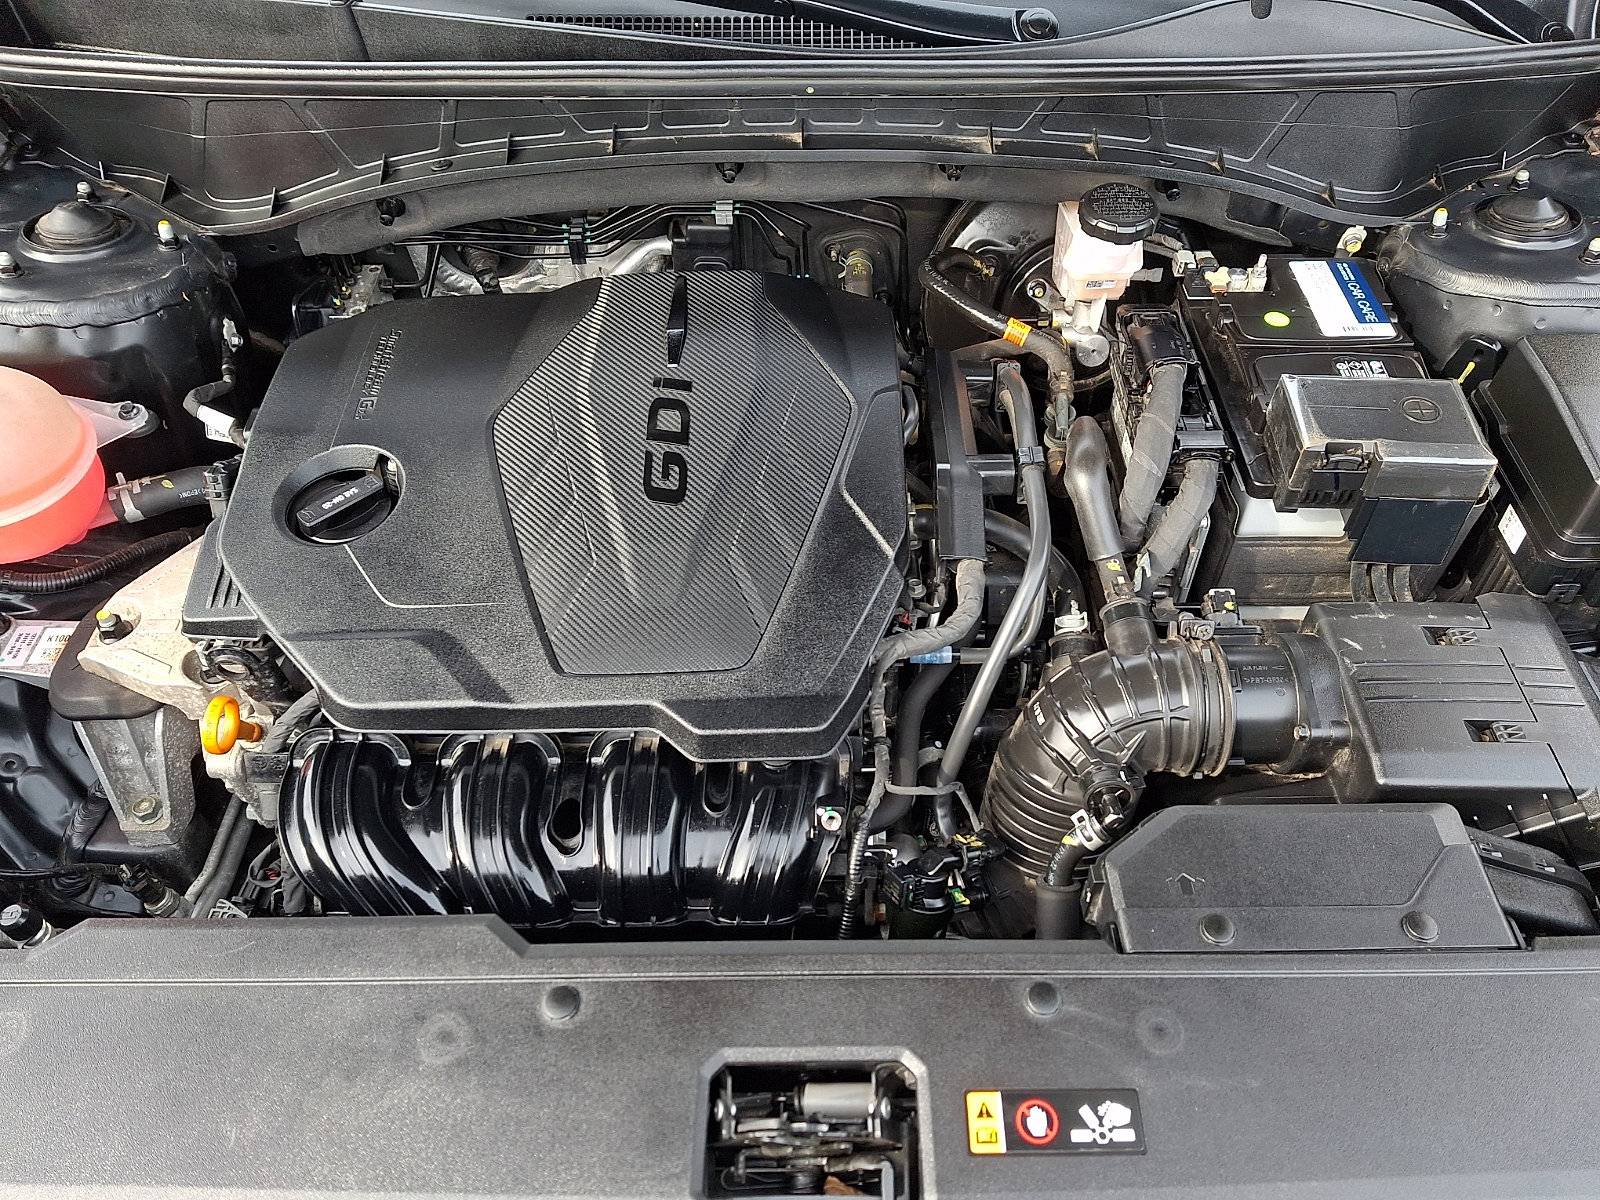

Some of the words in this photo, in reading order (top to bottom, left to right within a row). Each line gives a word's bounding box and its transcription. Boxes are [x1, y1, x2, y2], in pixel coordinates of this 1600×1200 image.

[1347, 282, 1366, 300] CAR
[1357, 300, 1379, 322] CARE
[643, 376, 693, 504] GDi
